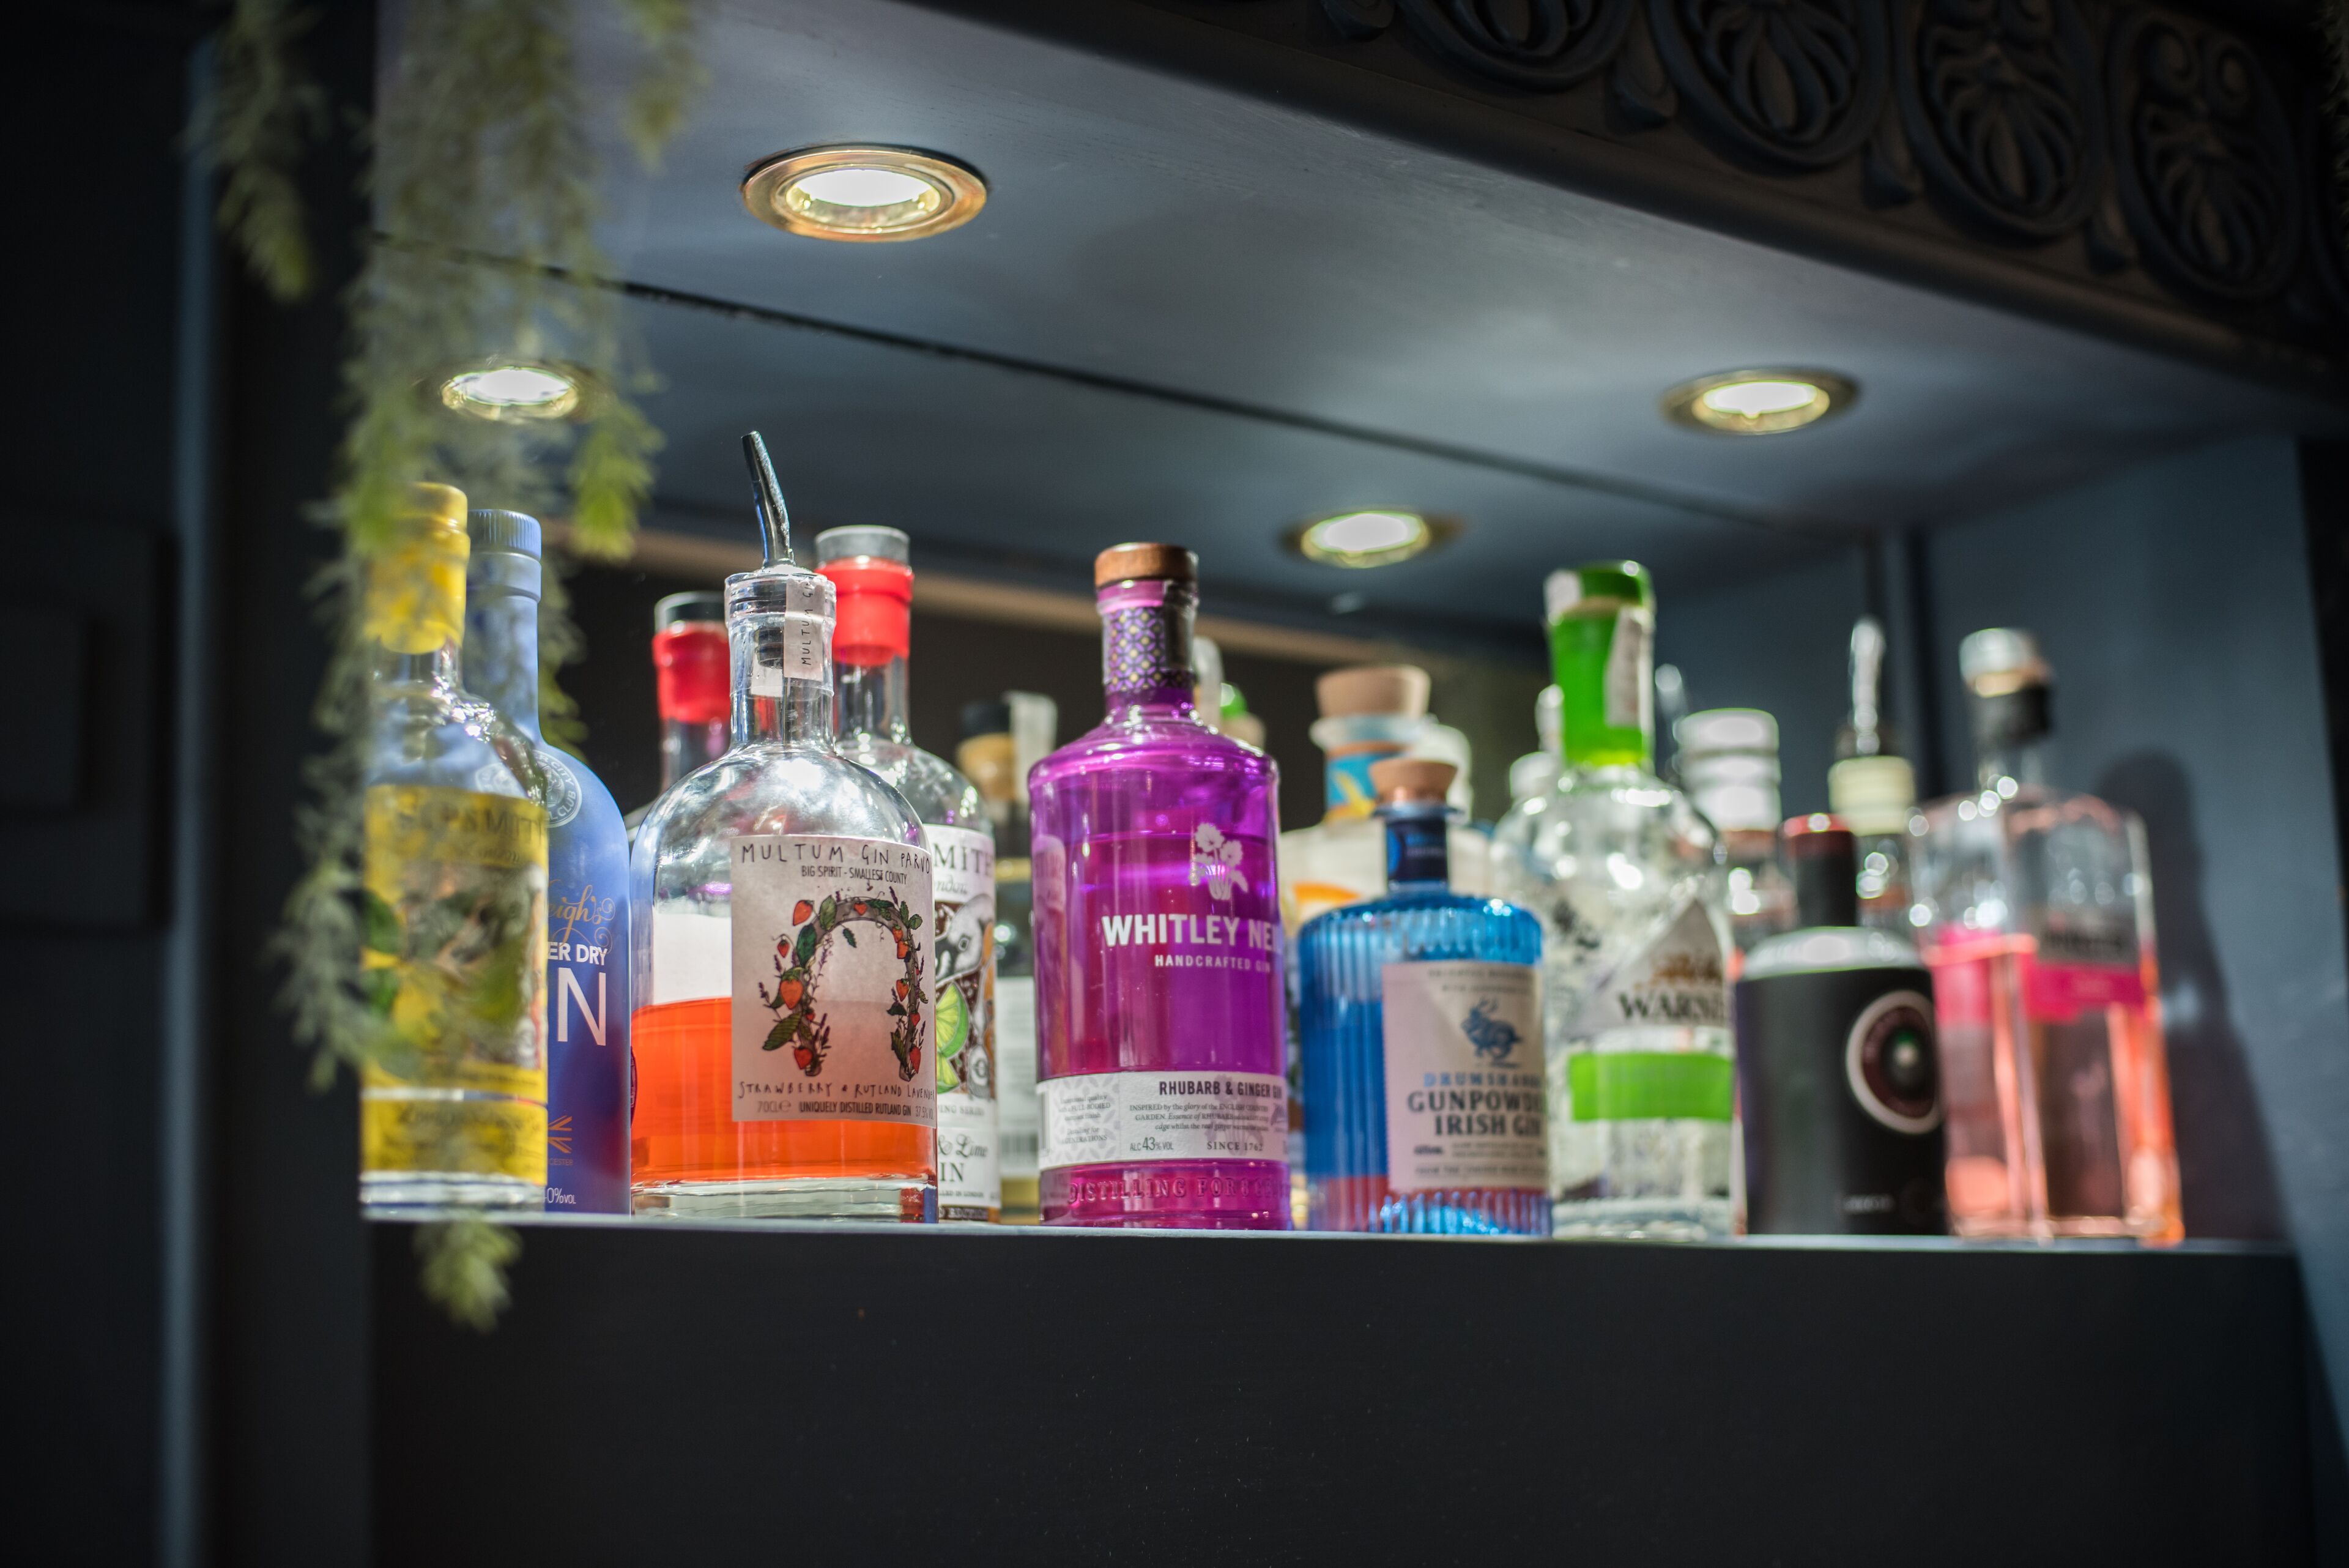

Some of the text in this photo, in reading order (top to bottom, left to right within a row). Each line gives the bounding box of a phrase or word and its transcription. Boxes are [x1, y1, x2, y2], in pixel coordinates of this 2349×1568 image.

[801, 608, 814, 666] MULTUM
[552, 761, 574, 786] CITY
[557, 790, 577, 818] CLUB
[741, 843, 930, 875] MULTUM GIN PARVO
[933, 843, 993, 877] MITH
[801, 865, 815, 877] BIG
[818, 866, 842, 878] SPIRIT
[849, 868, 884, 882] SMALLEST
[885, 870, 908, 885] COUNTY
[1101, 914, 1240, 947] WHITLEY
[548, 941, 607, 966] ER DRY
[1154, 954, 1251, 970] HANDCRAFTED
[557, 967, 607, 1046] N
[738, 1081, 833, 1099] STRAWBERRY
[855, 1083, 902, 1099] RUTLAND
[1159, 1081, 1220, 1096] RHUBARB
[1225, 1082, 1234, 1096] &
[1237, 1082, 1271, 1098] GINGER
[799, 1101, 837, 1113] UNIQUELY
[839, 1101, 873, 1114] DISTILLED
[875, 1102, 902, 1115] RUTLAND
[902, 1104, 911, 1117] GIN
[938, 1104, 957, 1114] ING
[1184, 1103, 1201, 1112] glory
[1194, 1113, 1201, 1121] of
[1155, 1123, 1170, 1132] edge
[1435, 1113, 1506, 1136] IRISH
[1130, 1142, 1141, 1151] ALC
[1162, 1142, 1174, 1150] VOL
[1206, 1141, 1264, 1151] SINCE 1762
[939, 1162, 965, 1182] IN
[1067, 1178, 1186, 1205] DISTILLING
